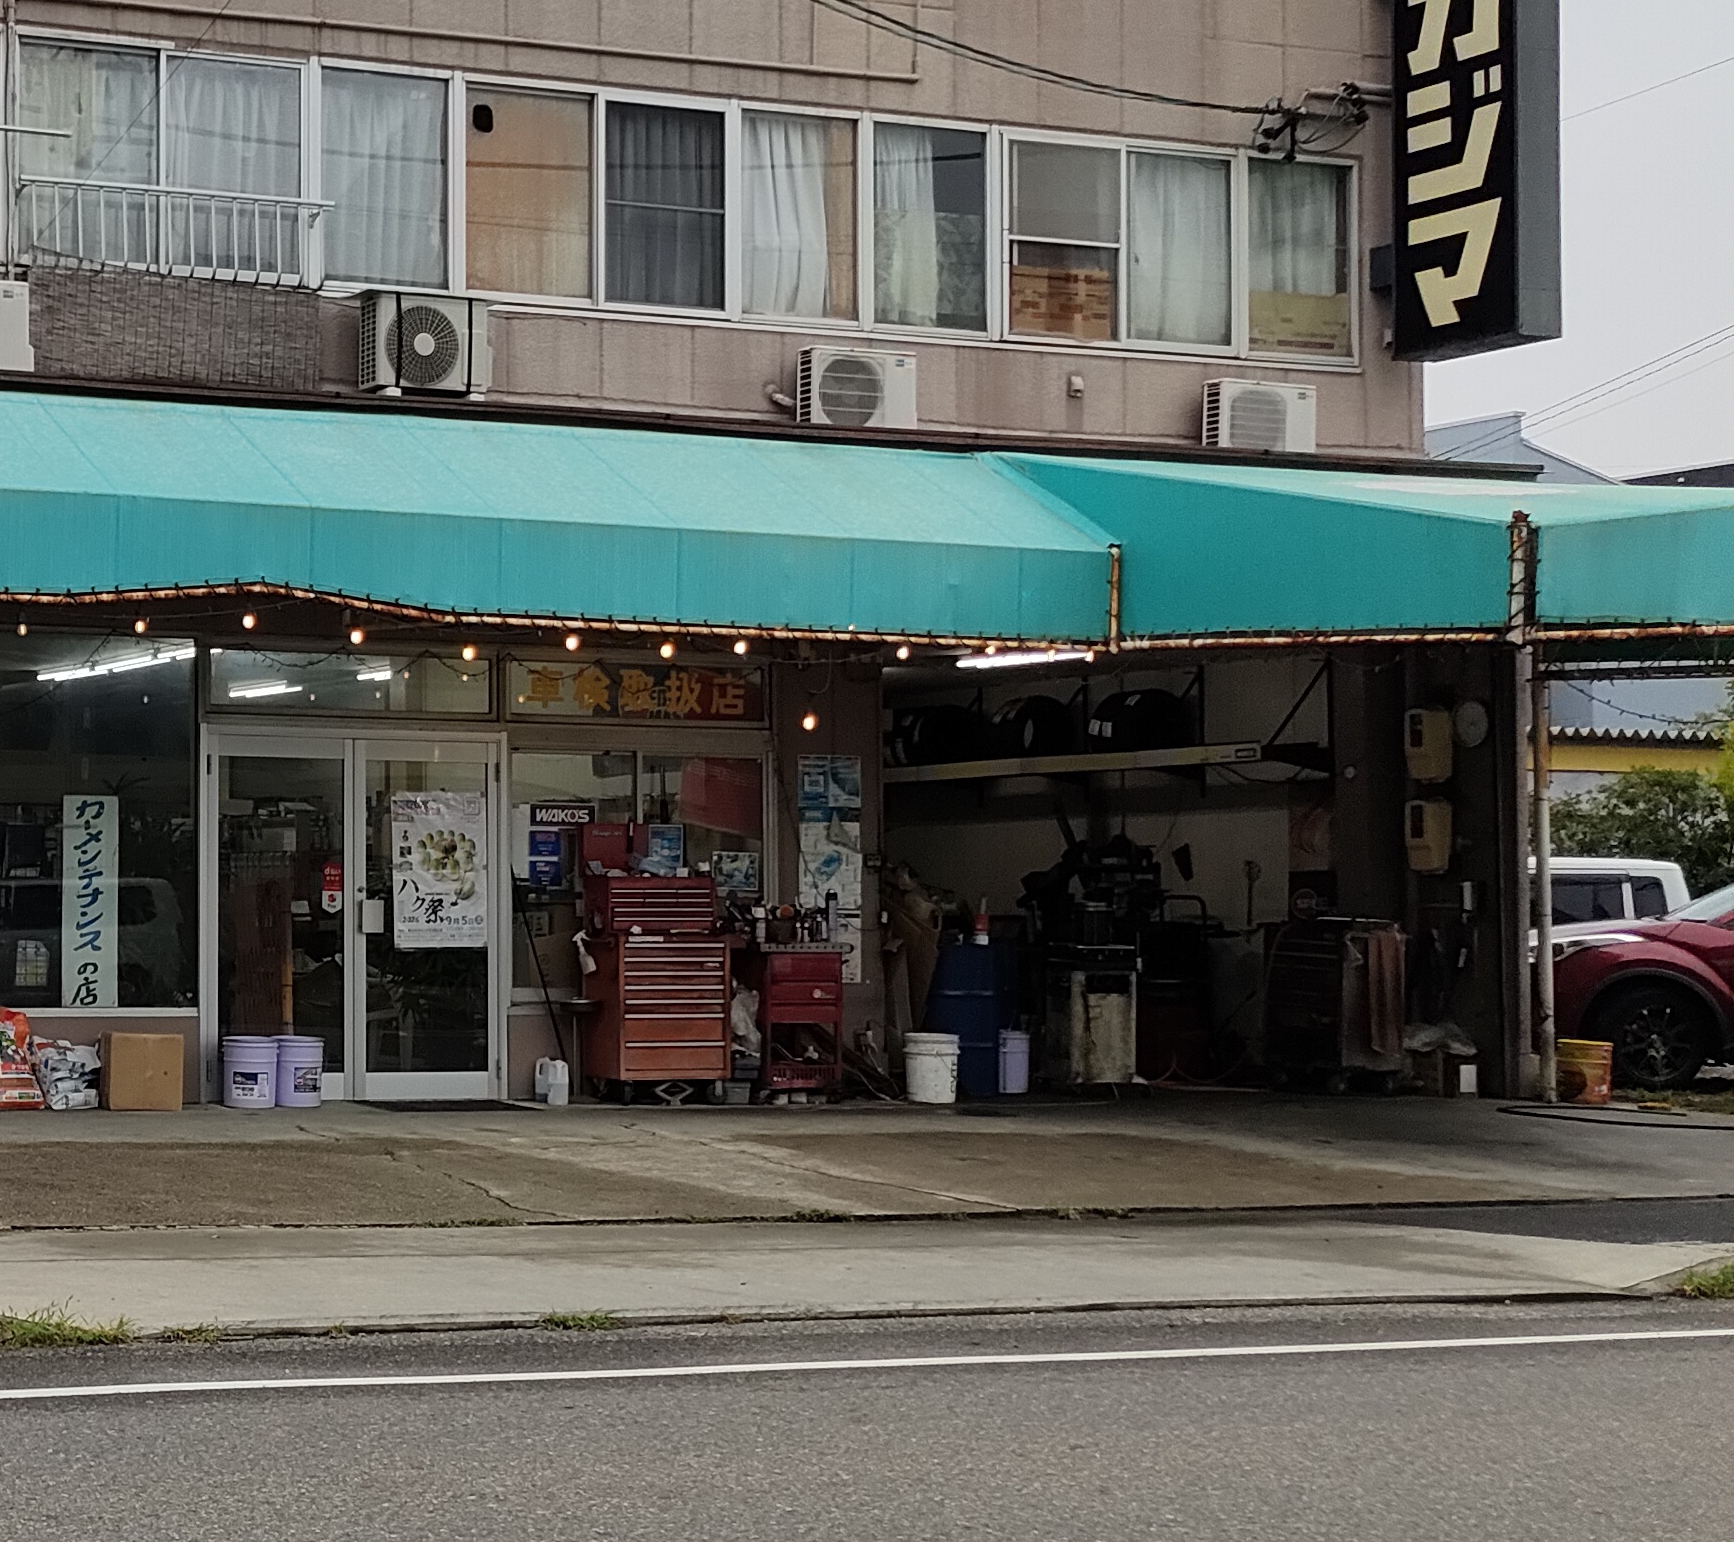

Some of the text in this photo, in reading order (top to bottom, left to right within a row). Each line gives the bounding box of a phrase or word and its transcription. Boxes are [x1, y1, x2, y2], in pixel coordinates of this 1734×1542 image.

[526, 665, 746, 715] 車検取扱店
